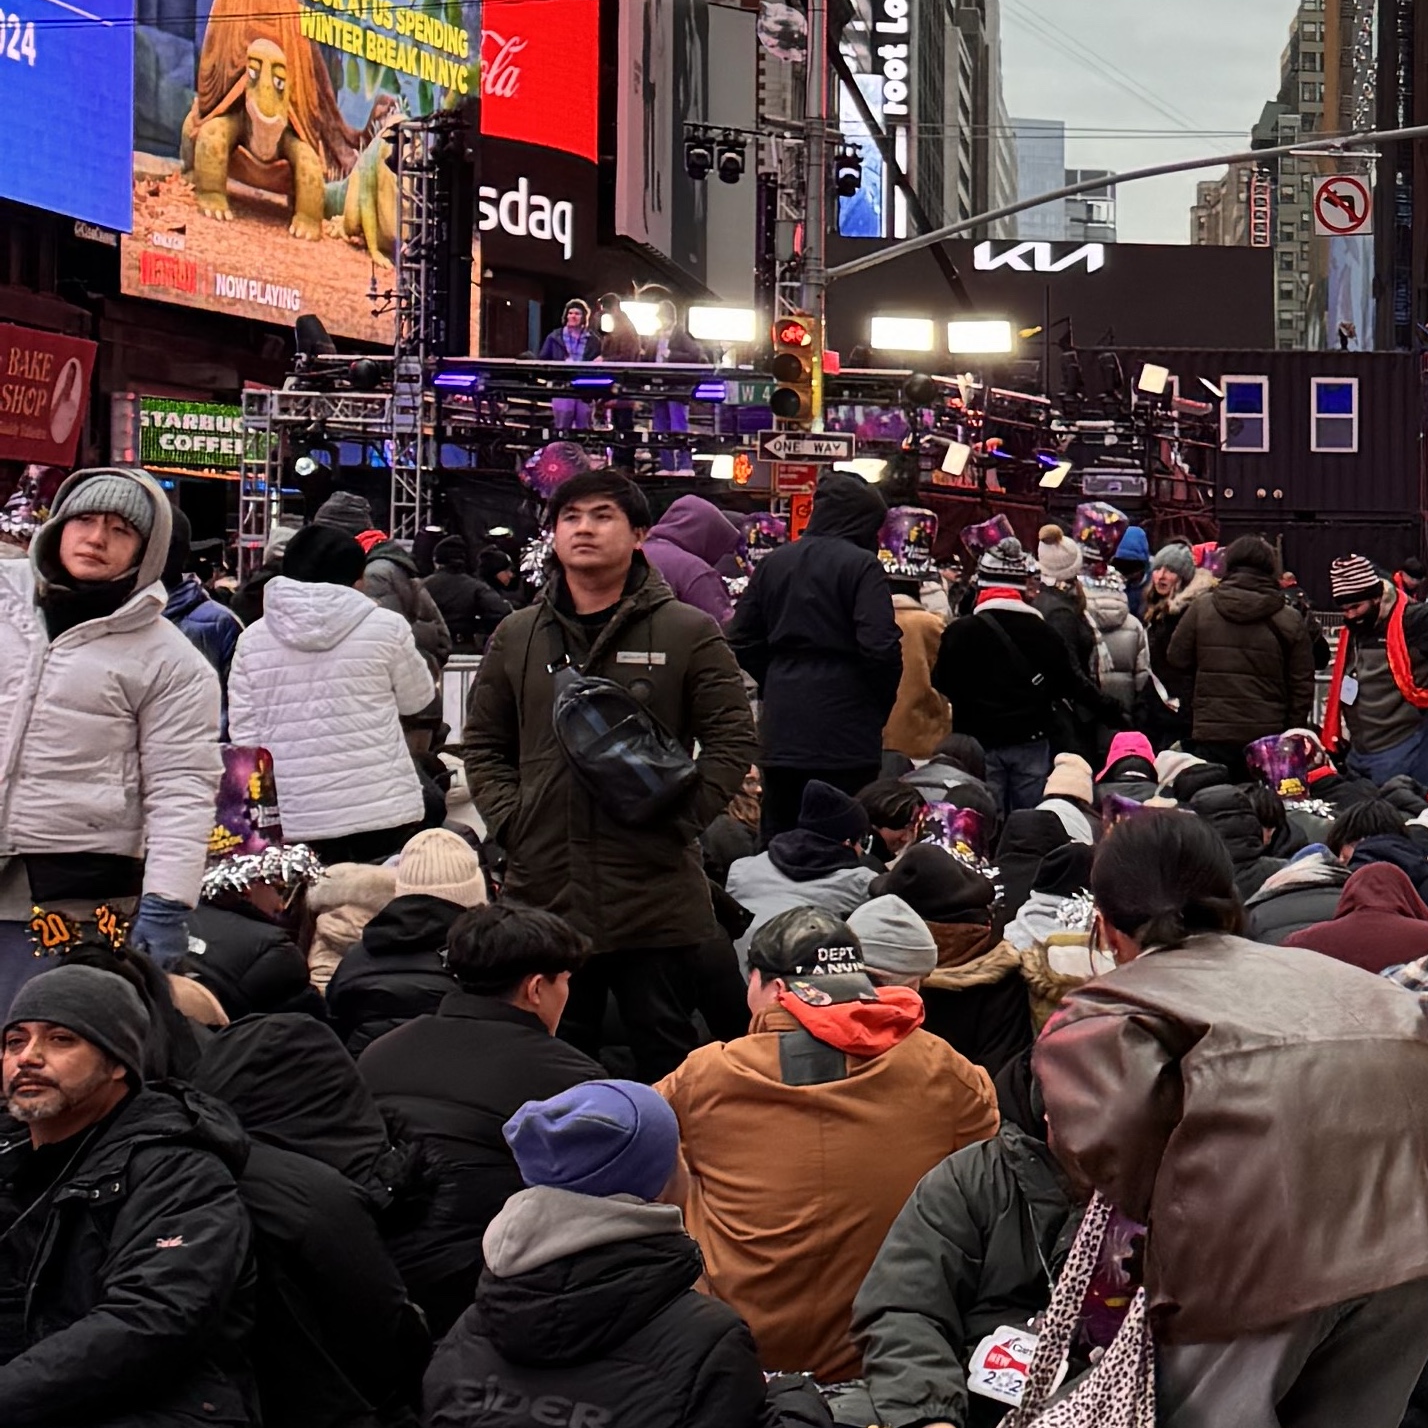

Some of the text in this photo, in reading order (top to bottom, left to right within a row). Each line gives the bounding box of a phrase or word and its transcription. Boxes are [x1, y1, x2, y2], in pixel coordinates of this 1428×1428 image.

[299, 3, 469, 95] WINTER BREAK IN NYC
[396, 6, 470, 59] SPENDING
[215, 272, 249, 299] NOW
[248, 276, 301, 311] PLAYING
[8, 346, 54, 384] BAKE
[741, 385, 755, 402] W
[773, 440, 842, 454] ONE WAY
[31, 913, 71, 948] 20
